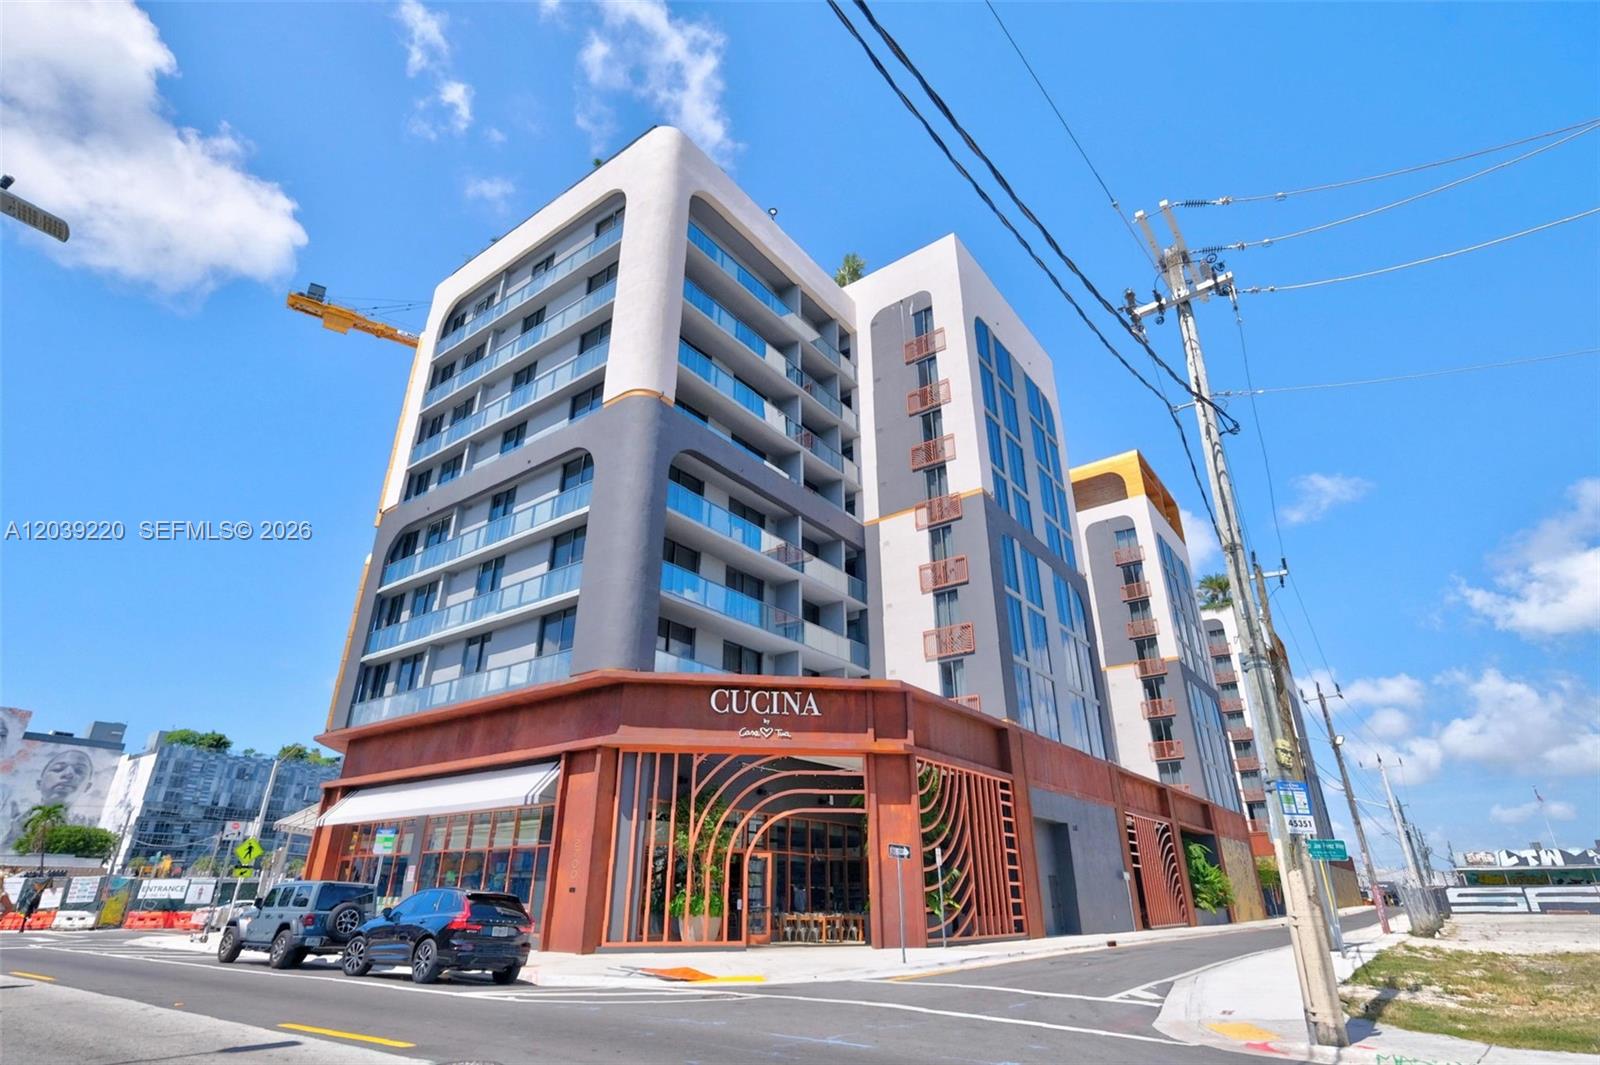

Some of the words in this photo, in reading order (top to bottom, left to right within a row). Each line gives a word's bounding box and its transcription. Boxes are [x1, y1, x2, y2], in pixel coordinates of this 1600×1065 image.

[710, 688, 822, 716] CUCINA
[739, 727, 760, 737] Casa
[775, 728, 791, 737] Tua
[1288, 819, 1313, 828] 45351
[141, 885, 186, 893] ENTRANCE
